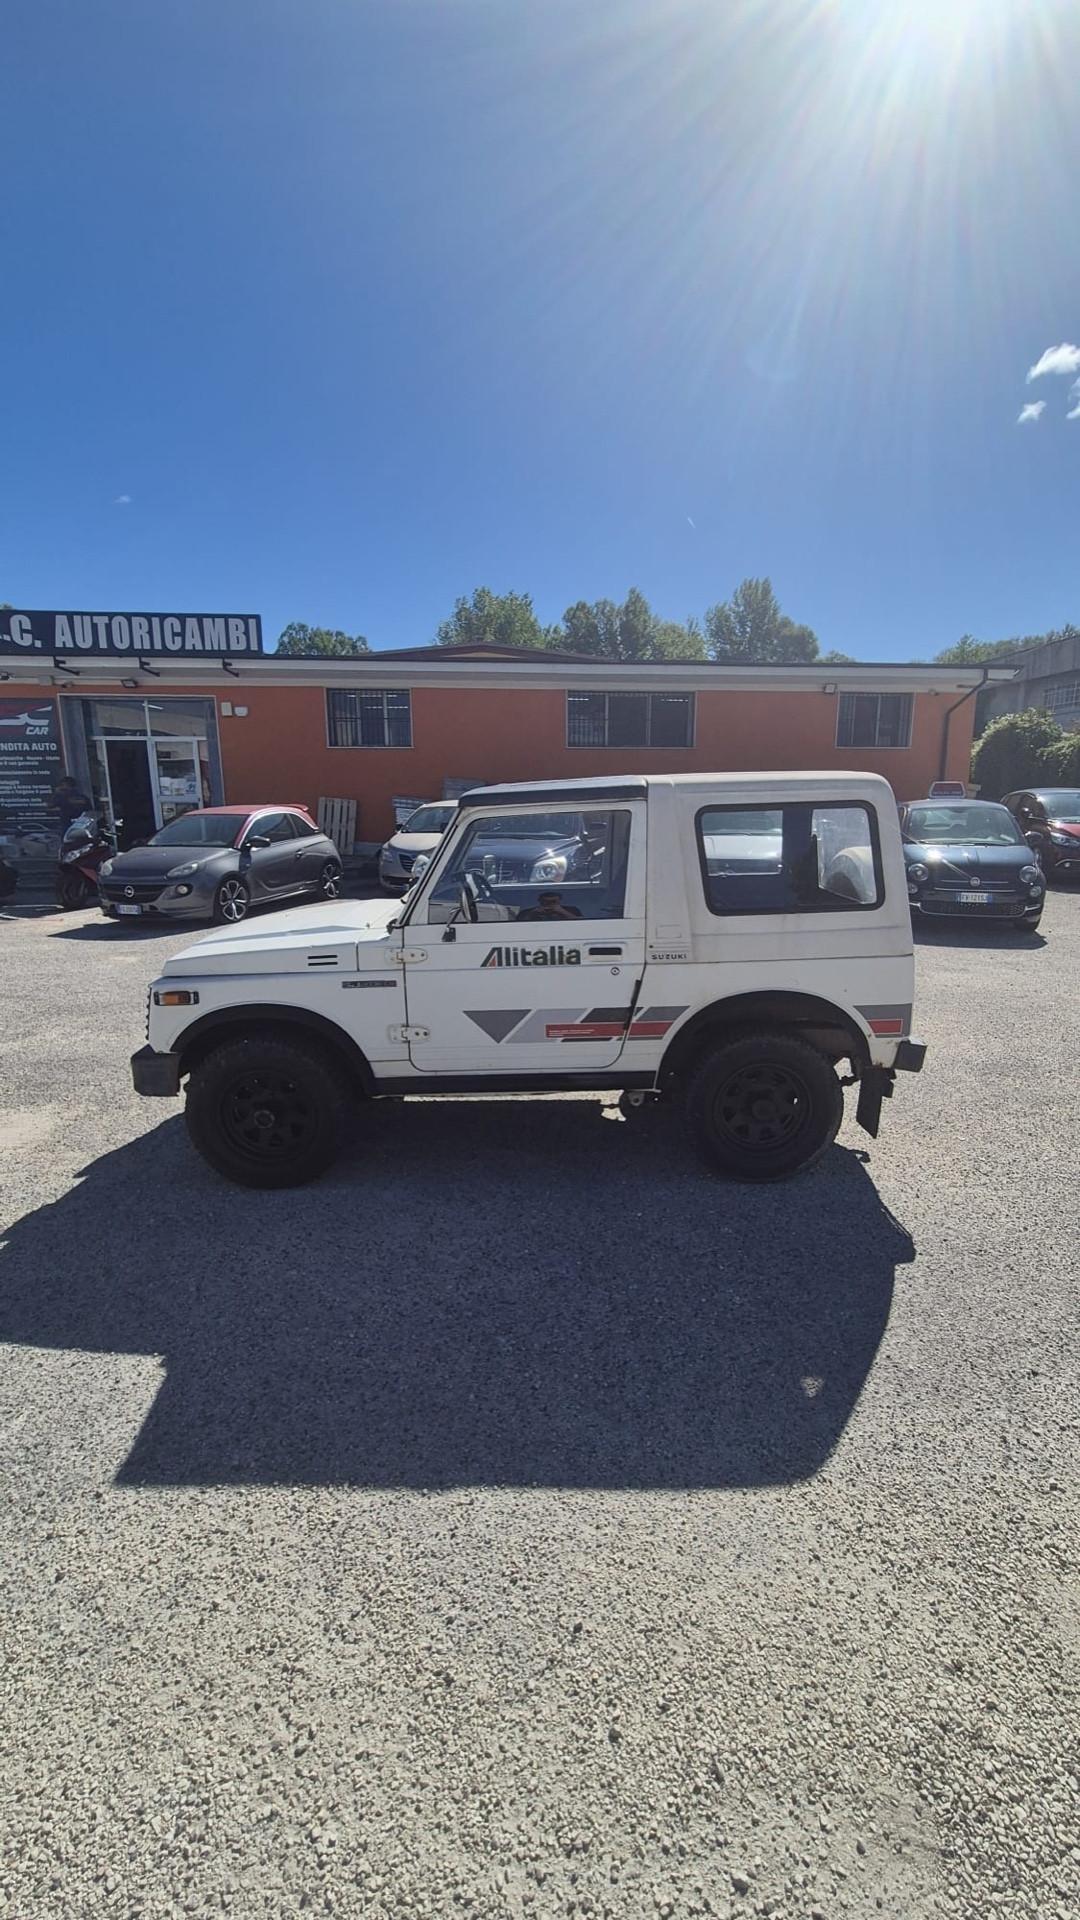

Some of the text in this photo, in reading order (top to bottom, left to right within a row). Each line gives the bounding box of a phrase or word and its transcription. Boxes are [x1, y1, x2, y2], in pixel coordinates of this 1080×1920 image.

[0, 614, 259, 651] .C. AUTORICAMBI
[25, 726, 49, 735] CAR
[31, 742, 58, 751] AUTO
[480, 945, 582, 968] Alitalia
